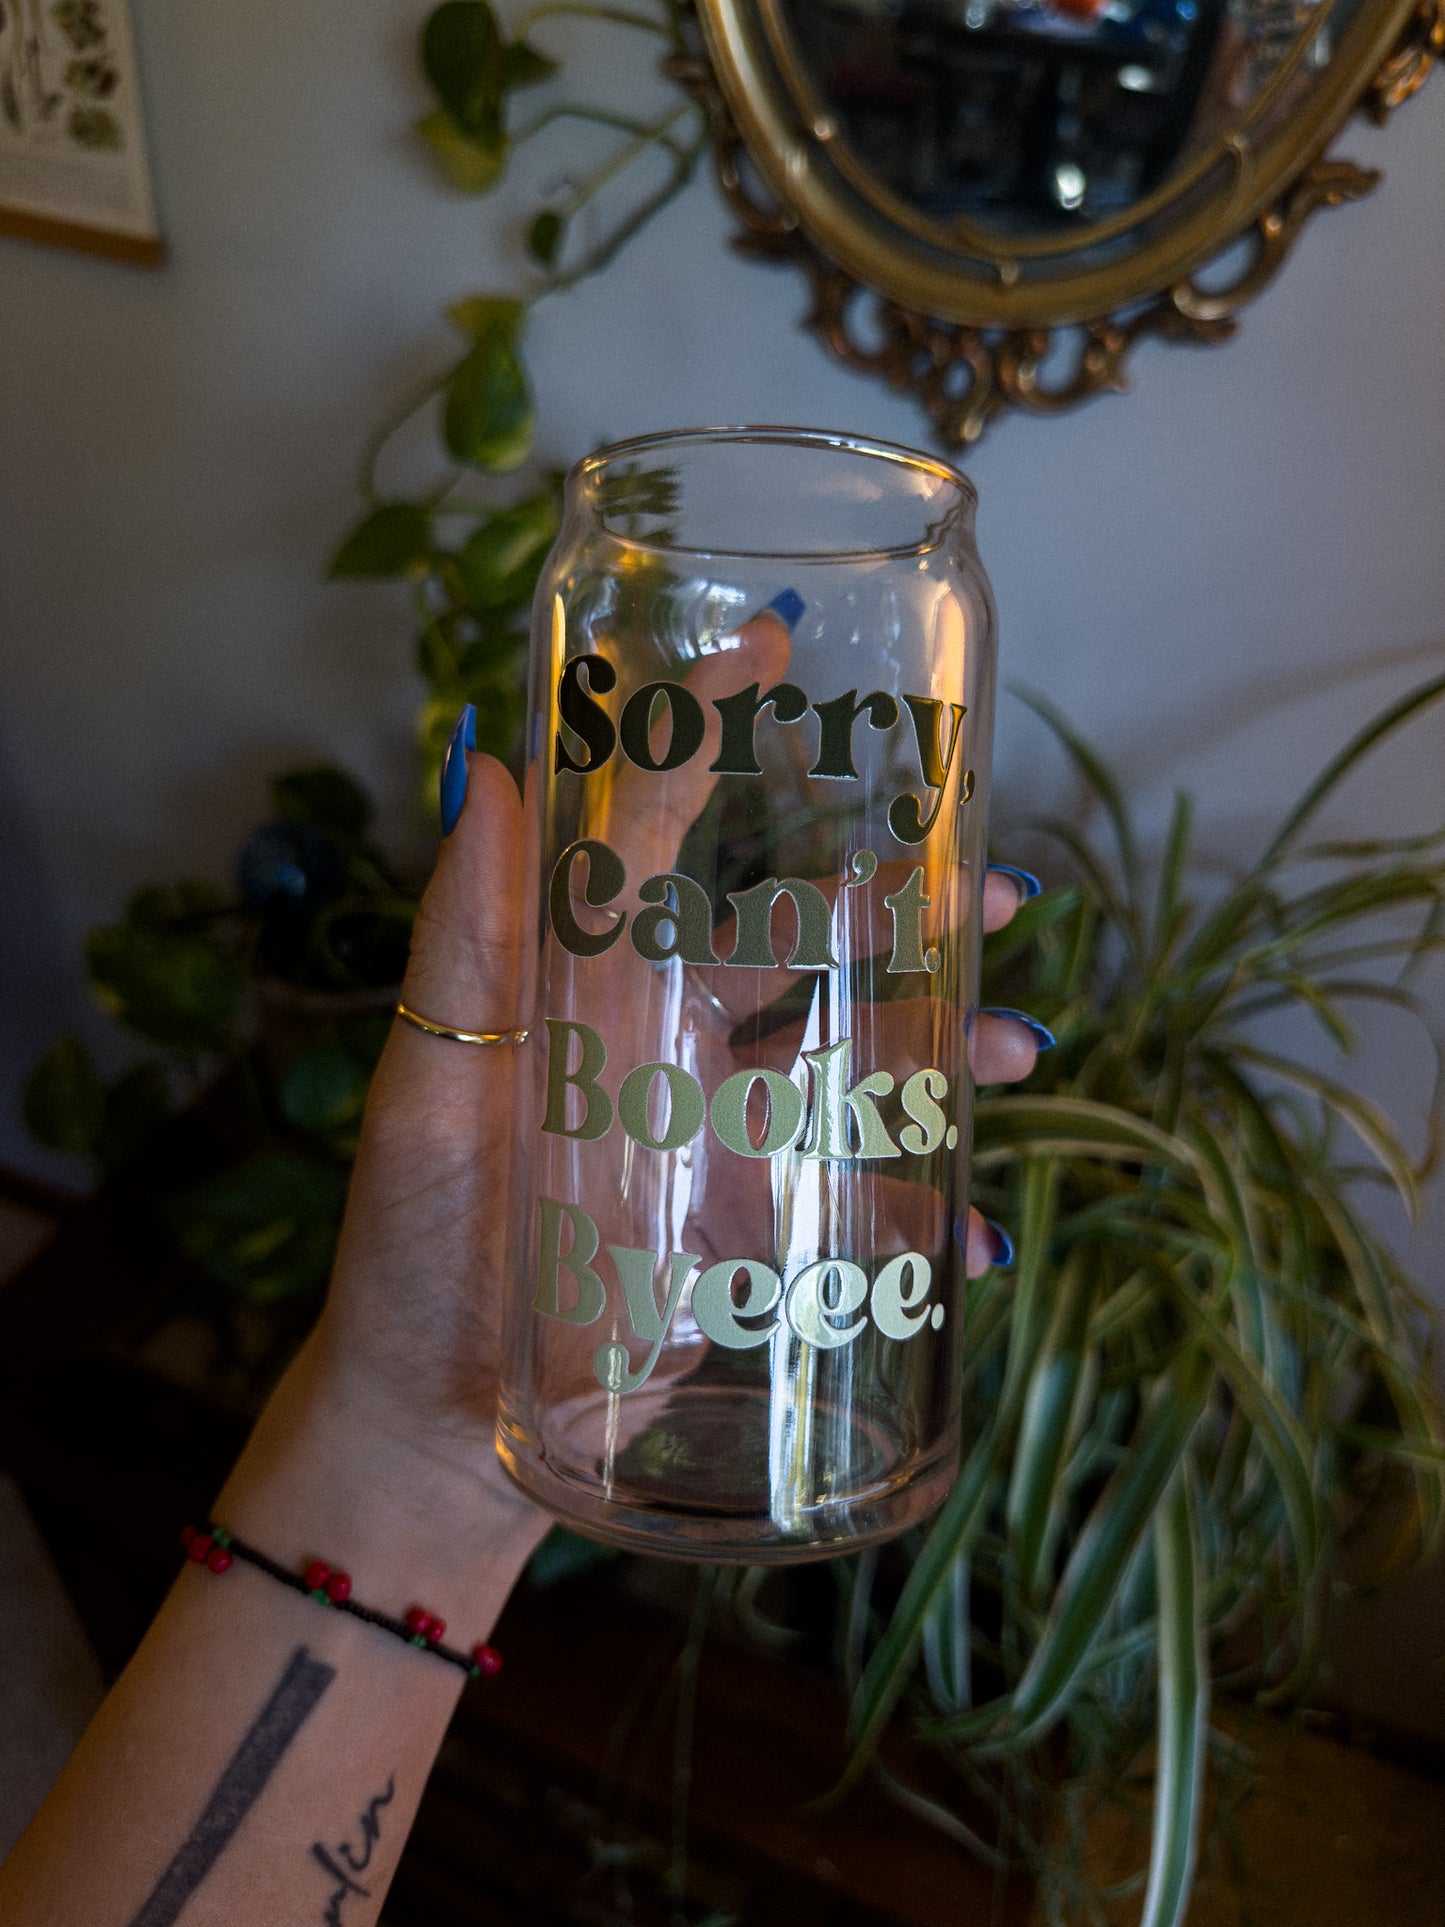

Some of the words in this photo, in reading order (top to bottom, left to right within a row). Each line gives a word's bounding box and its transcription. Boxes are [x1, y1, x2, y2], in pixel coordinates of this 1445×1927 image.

[554, 653, 975, 845] Sorry,
[541, 1017, 958, 1159] Books.
[532, 1196, 945, 1394] Byeee.
